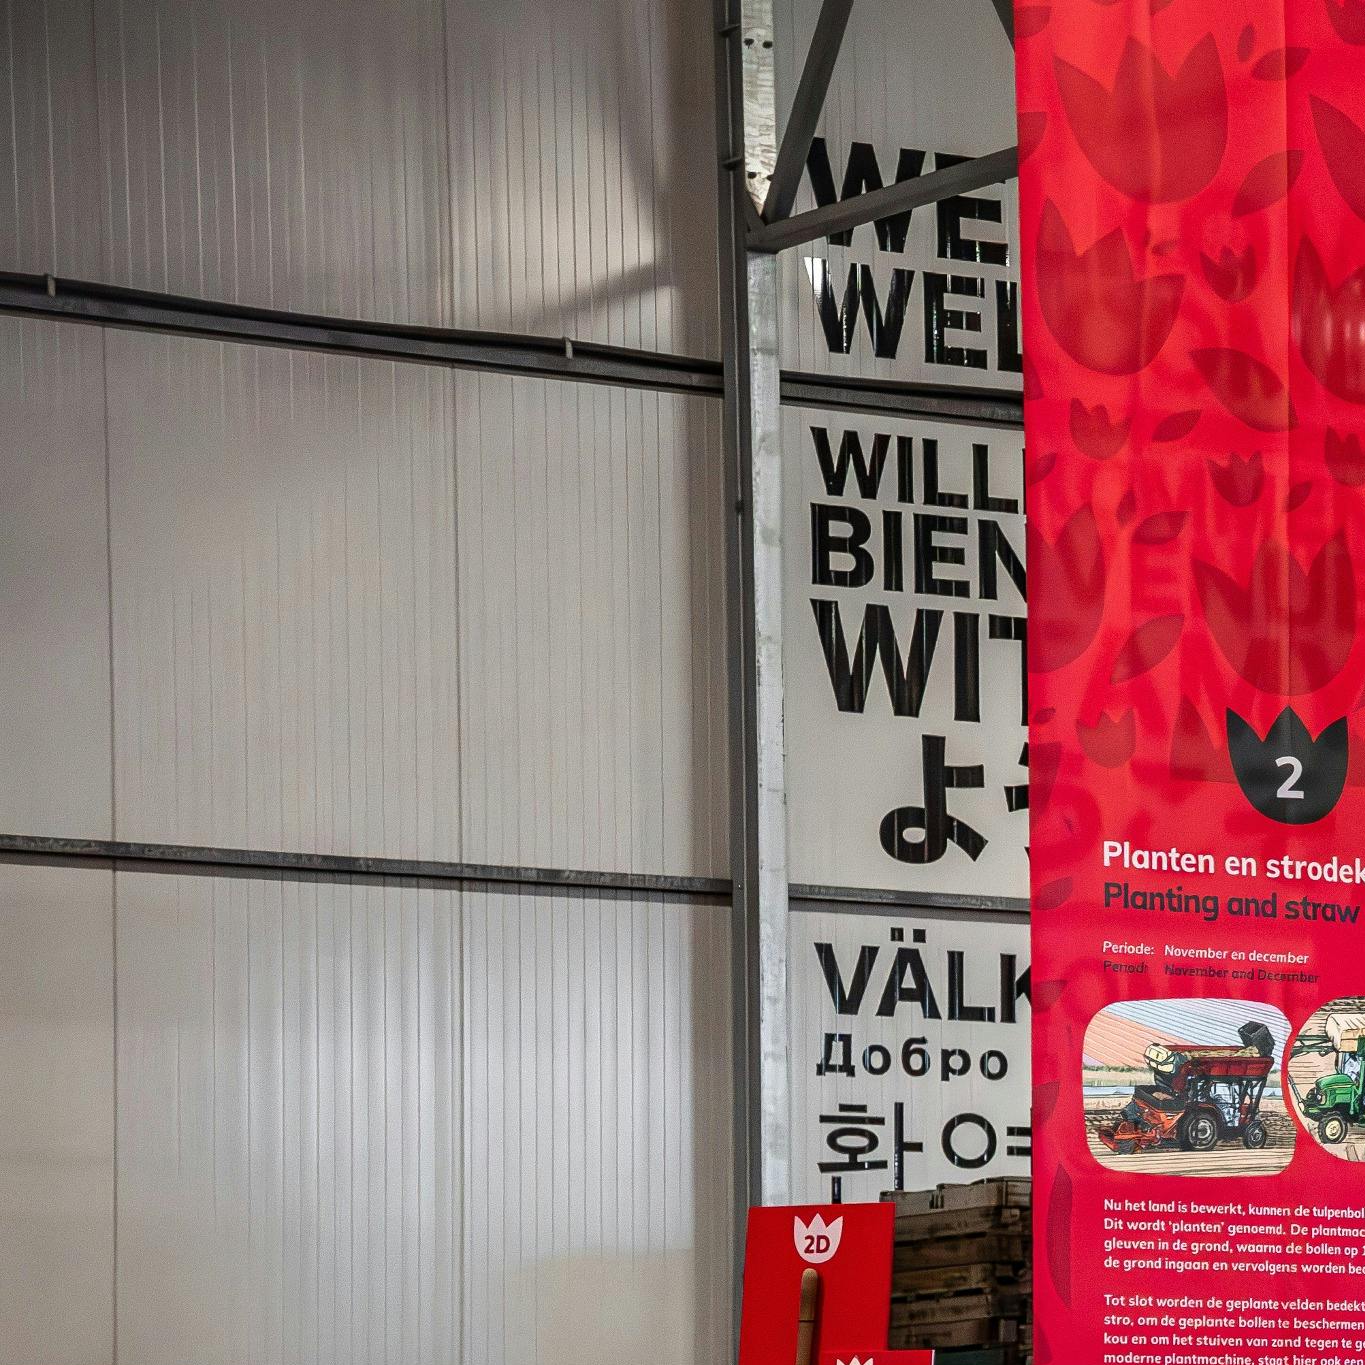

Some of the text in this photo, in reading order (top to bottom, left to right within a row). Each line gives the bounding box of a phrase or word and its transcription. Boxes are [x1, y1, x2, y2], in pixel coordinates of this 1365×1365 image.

[810, 427, 1025, 514] WILL
[810, 502, 1027, 603] BIEN
[1274, 755, 1305, 800] 2
[879, 734, 1029, 864] よ
[1103, 841, 1215, 874] Planten
[1225, 857, 1256, 876] en
[1104, 882, 1219, 921] Planting
[1228, 893, 1277, 919] and
[1285, 896, 1360, 924] straw
[1103, 942, 1309, 963] Periode: November en december
[816, 1033, 1008, 1082] Добро
[1104, 1199, 1121, 1210] Nu
[1125, 1200, 1145, 1211] het
[1149, 1200, 1174, 1212] land
[1178, 1201, 1187, 1213] is
[1191, 1202, 1245, 1216] bewerkt,
[1249, 1204, 1290, 1216] kunnen
[1294, 1205, 1310, 1216] de
[804, 1235, 830, 1253] 2D
[1104, 1218, 1123, 1229] Dit
[1127, 1220, 1165, 1231] wordt
[1228, 1224, 1285, 1236] genoemd.
[1291, 1224, 1308, 1235] De
[1104, 1237, 1154, 1251] gleuven
[1158, 1239, 1169, 1250] in
[1173, 1239, 1187, 1250] de
[1191, 1241, 1233, 1254] grond,
[1237, 1244, 1282, 1253] waarna
[1286, 1243, 1302, 1253] de
[1306, 1243, 1341, 1254] bollen
[1344, 1247, 1358, 1258] op
[1104, 1256, 1119, 1267] de
[1124, 1258, 1161, 1271] grond
[1165, 1258, 1209, 1272] ingaan
[1213, 1262, 1228, 1270] en
[1232, 1261, 1297, 1275] vervolgens
[1301, 1262, 1345, 1273] worden
